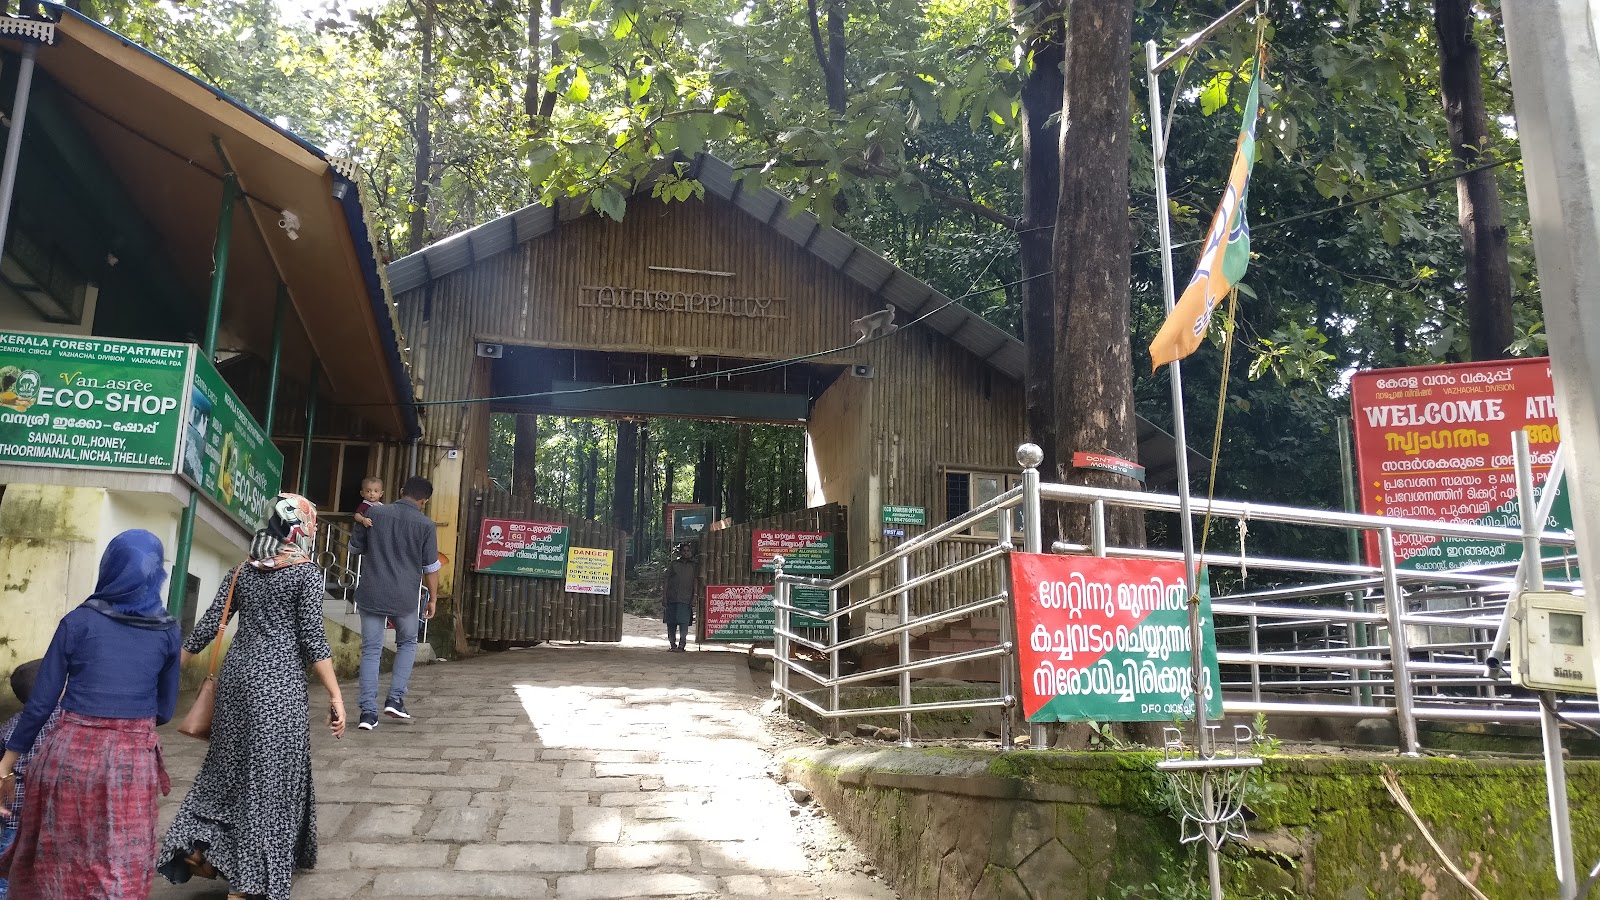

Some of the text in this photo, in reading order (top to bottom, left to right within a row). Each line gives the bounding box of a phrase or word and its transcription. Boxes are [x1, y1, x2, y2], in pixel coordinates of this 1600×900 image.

[0, 334, 184, 358] KERALA FOREST DEPARTMENT
[28, 348, 52, 356] CIRCLE
[59, 351, 96, 360] VAZHACHAL
[97, 354, 125, 362] DIVISION
[131, 357, 167, 366] VAZHACHAL
[1376, 368, 1513, 389] കേരള വനം വകുപ്പ്
[1485, 384, 1515, 392] DIVISION
[37, 387, 177, 415] ECO-SHOP
[1, 413, 50, 428] വനശ്രീ
[1363, 399, 1505, 427] WELCOME
[28, 431, 69, 445] SANDAL
[1385, 428, 1490, 455] സ്വാഗതം
[149, 454, 170, 466] etc...
[1090, 462, 1128, 473] MONKEYS
[1381, 456, 1485, 472] സന്ദർശകരുടെ
[1383, 477, 1437, 491] പ്രവേശന
[1441, 475, 1482, 487] സമയം
[1488, 474, 1498, 484] 8
[1500, 473, 1515, 484] AM
[1385, 488, 1463, 504] പ്രവേശനത്തിന്
[1467, 486, 1498, 502] ടിക്കറ്റ്
[1440, 501, 1490, 517] പുകവലി
[573, 549, 608, 557] DANGER
[1394, 543, 1506, 560] പുഴയിൽ ഇറങ്ങരുത്
[1039, 572, 1188, 619] ഗേറ്റിനു മുന്നിൽ
[1031, 624, 1114, 660] കച്ചവടം
[1141, 703, 1161, 713] DFO
